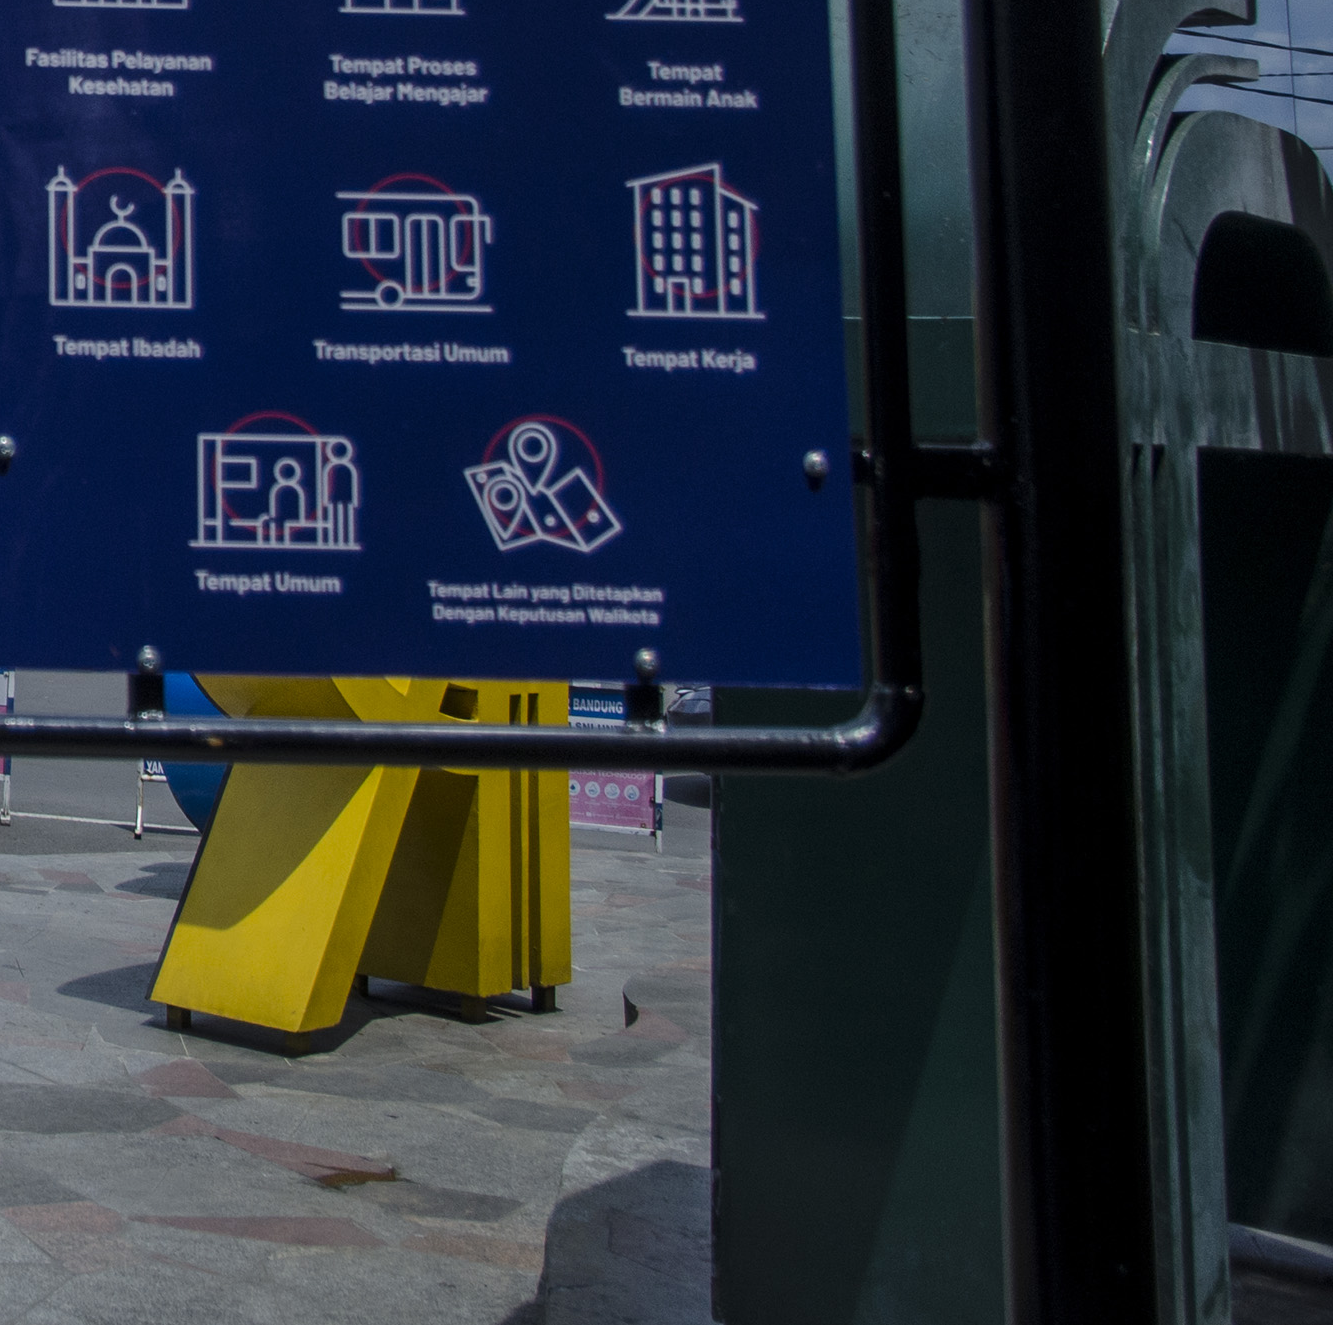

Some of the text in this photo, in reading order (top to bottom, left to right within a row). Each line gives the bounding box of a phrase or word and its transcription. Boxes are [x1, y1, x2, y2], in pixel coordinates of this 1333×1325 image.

[25, 47, 213, 74] Fasilitas Pelayanan
[329, 53, 478, 78] Tempat Proses
[647, 60, 724, 85] Tempat
[68, 75, 175, 97] Kesehatan
[323, 80, 489, 107] Belajar Mengajar
[619, 86, 758, 109] Bermain Anak
[53, 334, 202, 361] Tempat Ibadah
[313, 339, 511, 365] Transportasi Umum
[622, 346, 757, 374] Tempat Kerja
[195, 569, 342, 596] Tempat Umum
[427, 580, 664, 605] Tempat Lain yang Ditetapkan
[432, 603, 660, 626] Dengan Keputusan Walikota
[572, 697, 624, 715] BANDUNG
